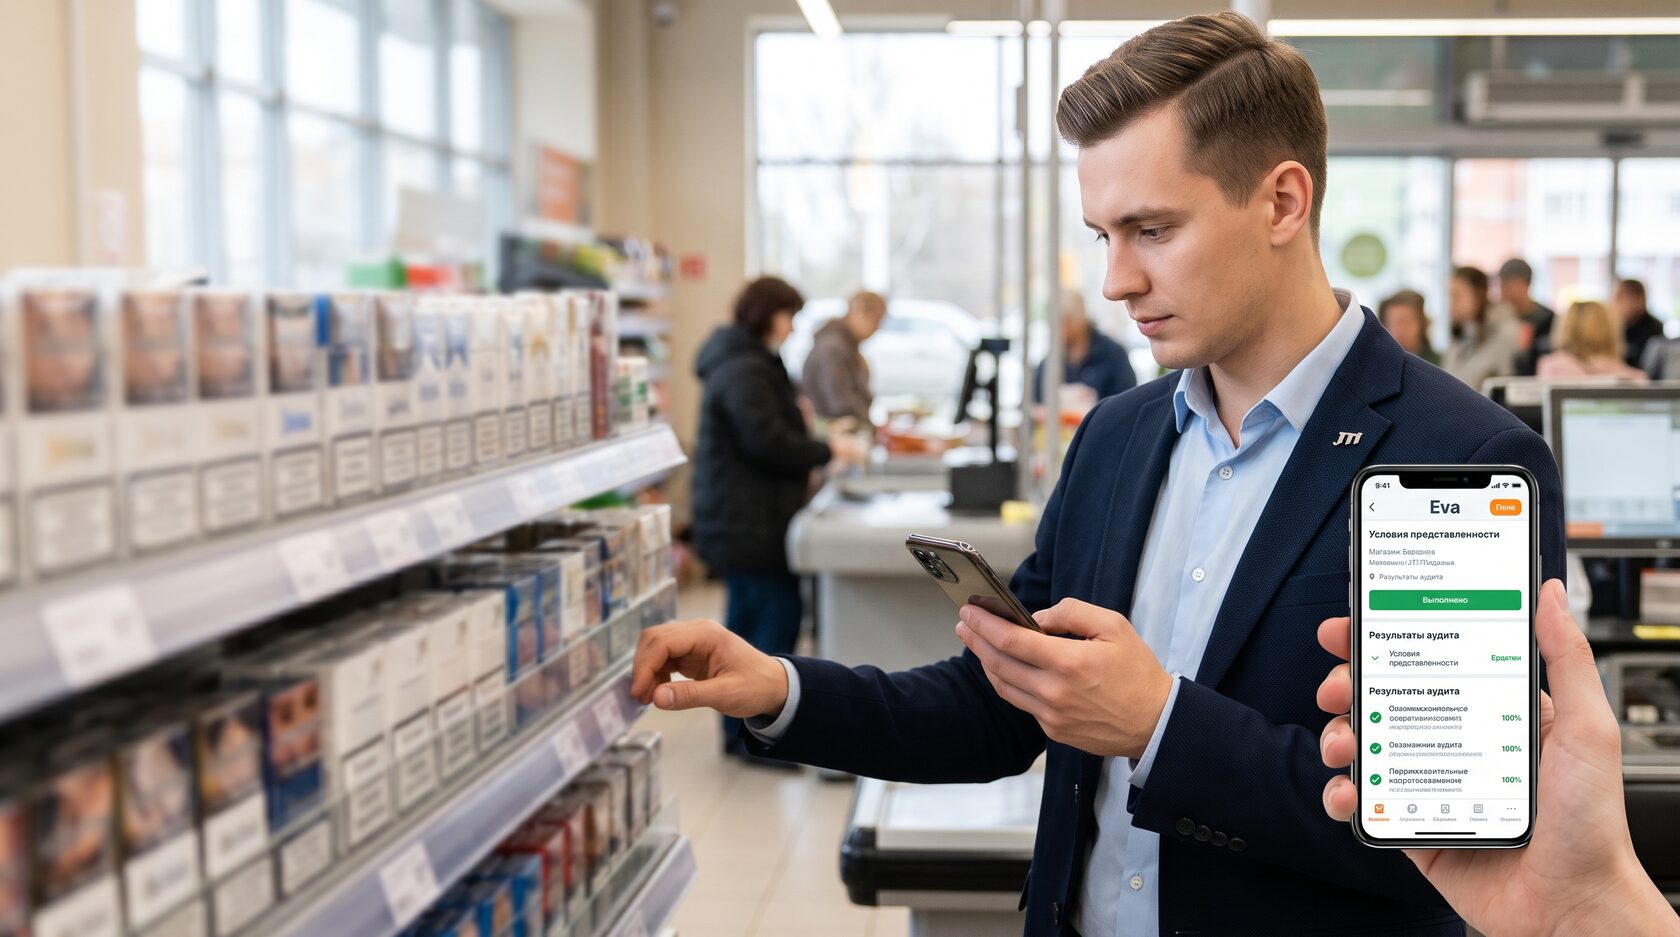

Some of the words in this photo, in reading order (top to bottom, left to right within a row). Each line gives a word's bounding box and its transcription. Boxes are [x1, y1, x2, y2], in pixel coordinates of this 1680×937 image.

[1430, 499, 1461, 514] Eva
[1369, 530, 1409, 539] Условия
[1410, 531, 1500, 540] представленности
[1422, 596, 1469, 604] Выполнено
[1369, 631, 1425, 641] Результаты
[1426, 632, 1460, 640] аудита
[1389, 650, 1421, 658] Условия
[1369, 687, 1425, 697] Результаты
[1426, 688, 1460, 696] аудита
[1436, 742, 1463, 750] аудита
